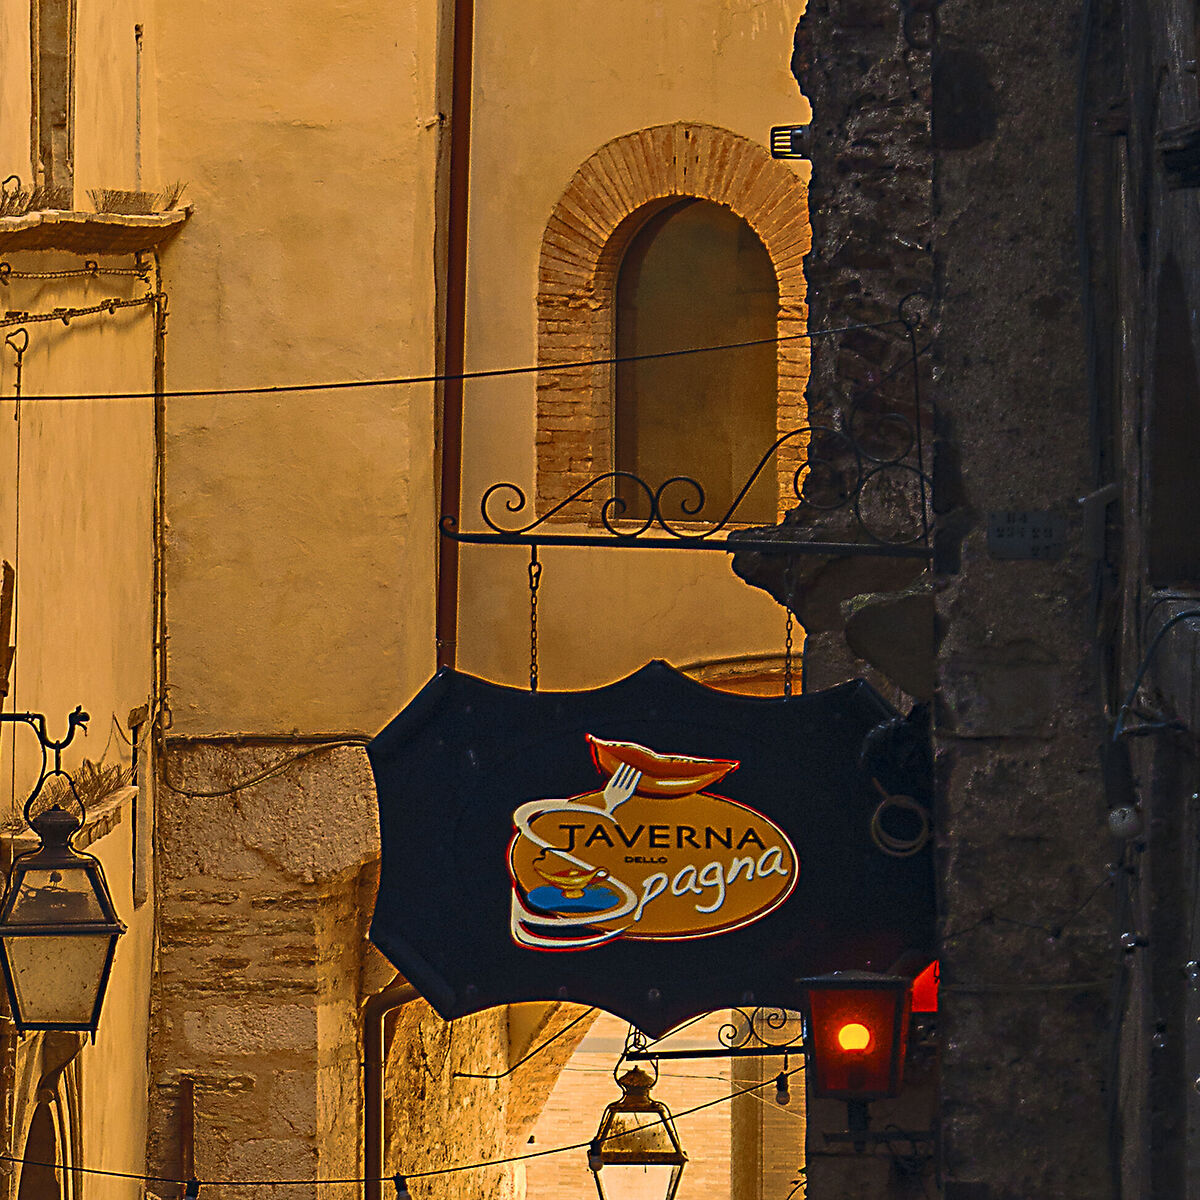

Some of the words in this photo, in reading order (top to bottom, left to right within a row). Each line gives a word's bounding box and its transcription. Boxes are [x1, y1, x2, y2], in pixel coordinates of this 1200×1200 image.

[556, 823, 767, 852] TAVERNA
[510, 798, 789, 947] Spagna
[624, 856, 668, 865] DELLO
